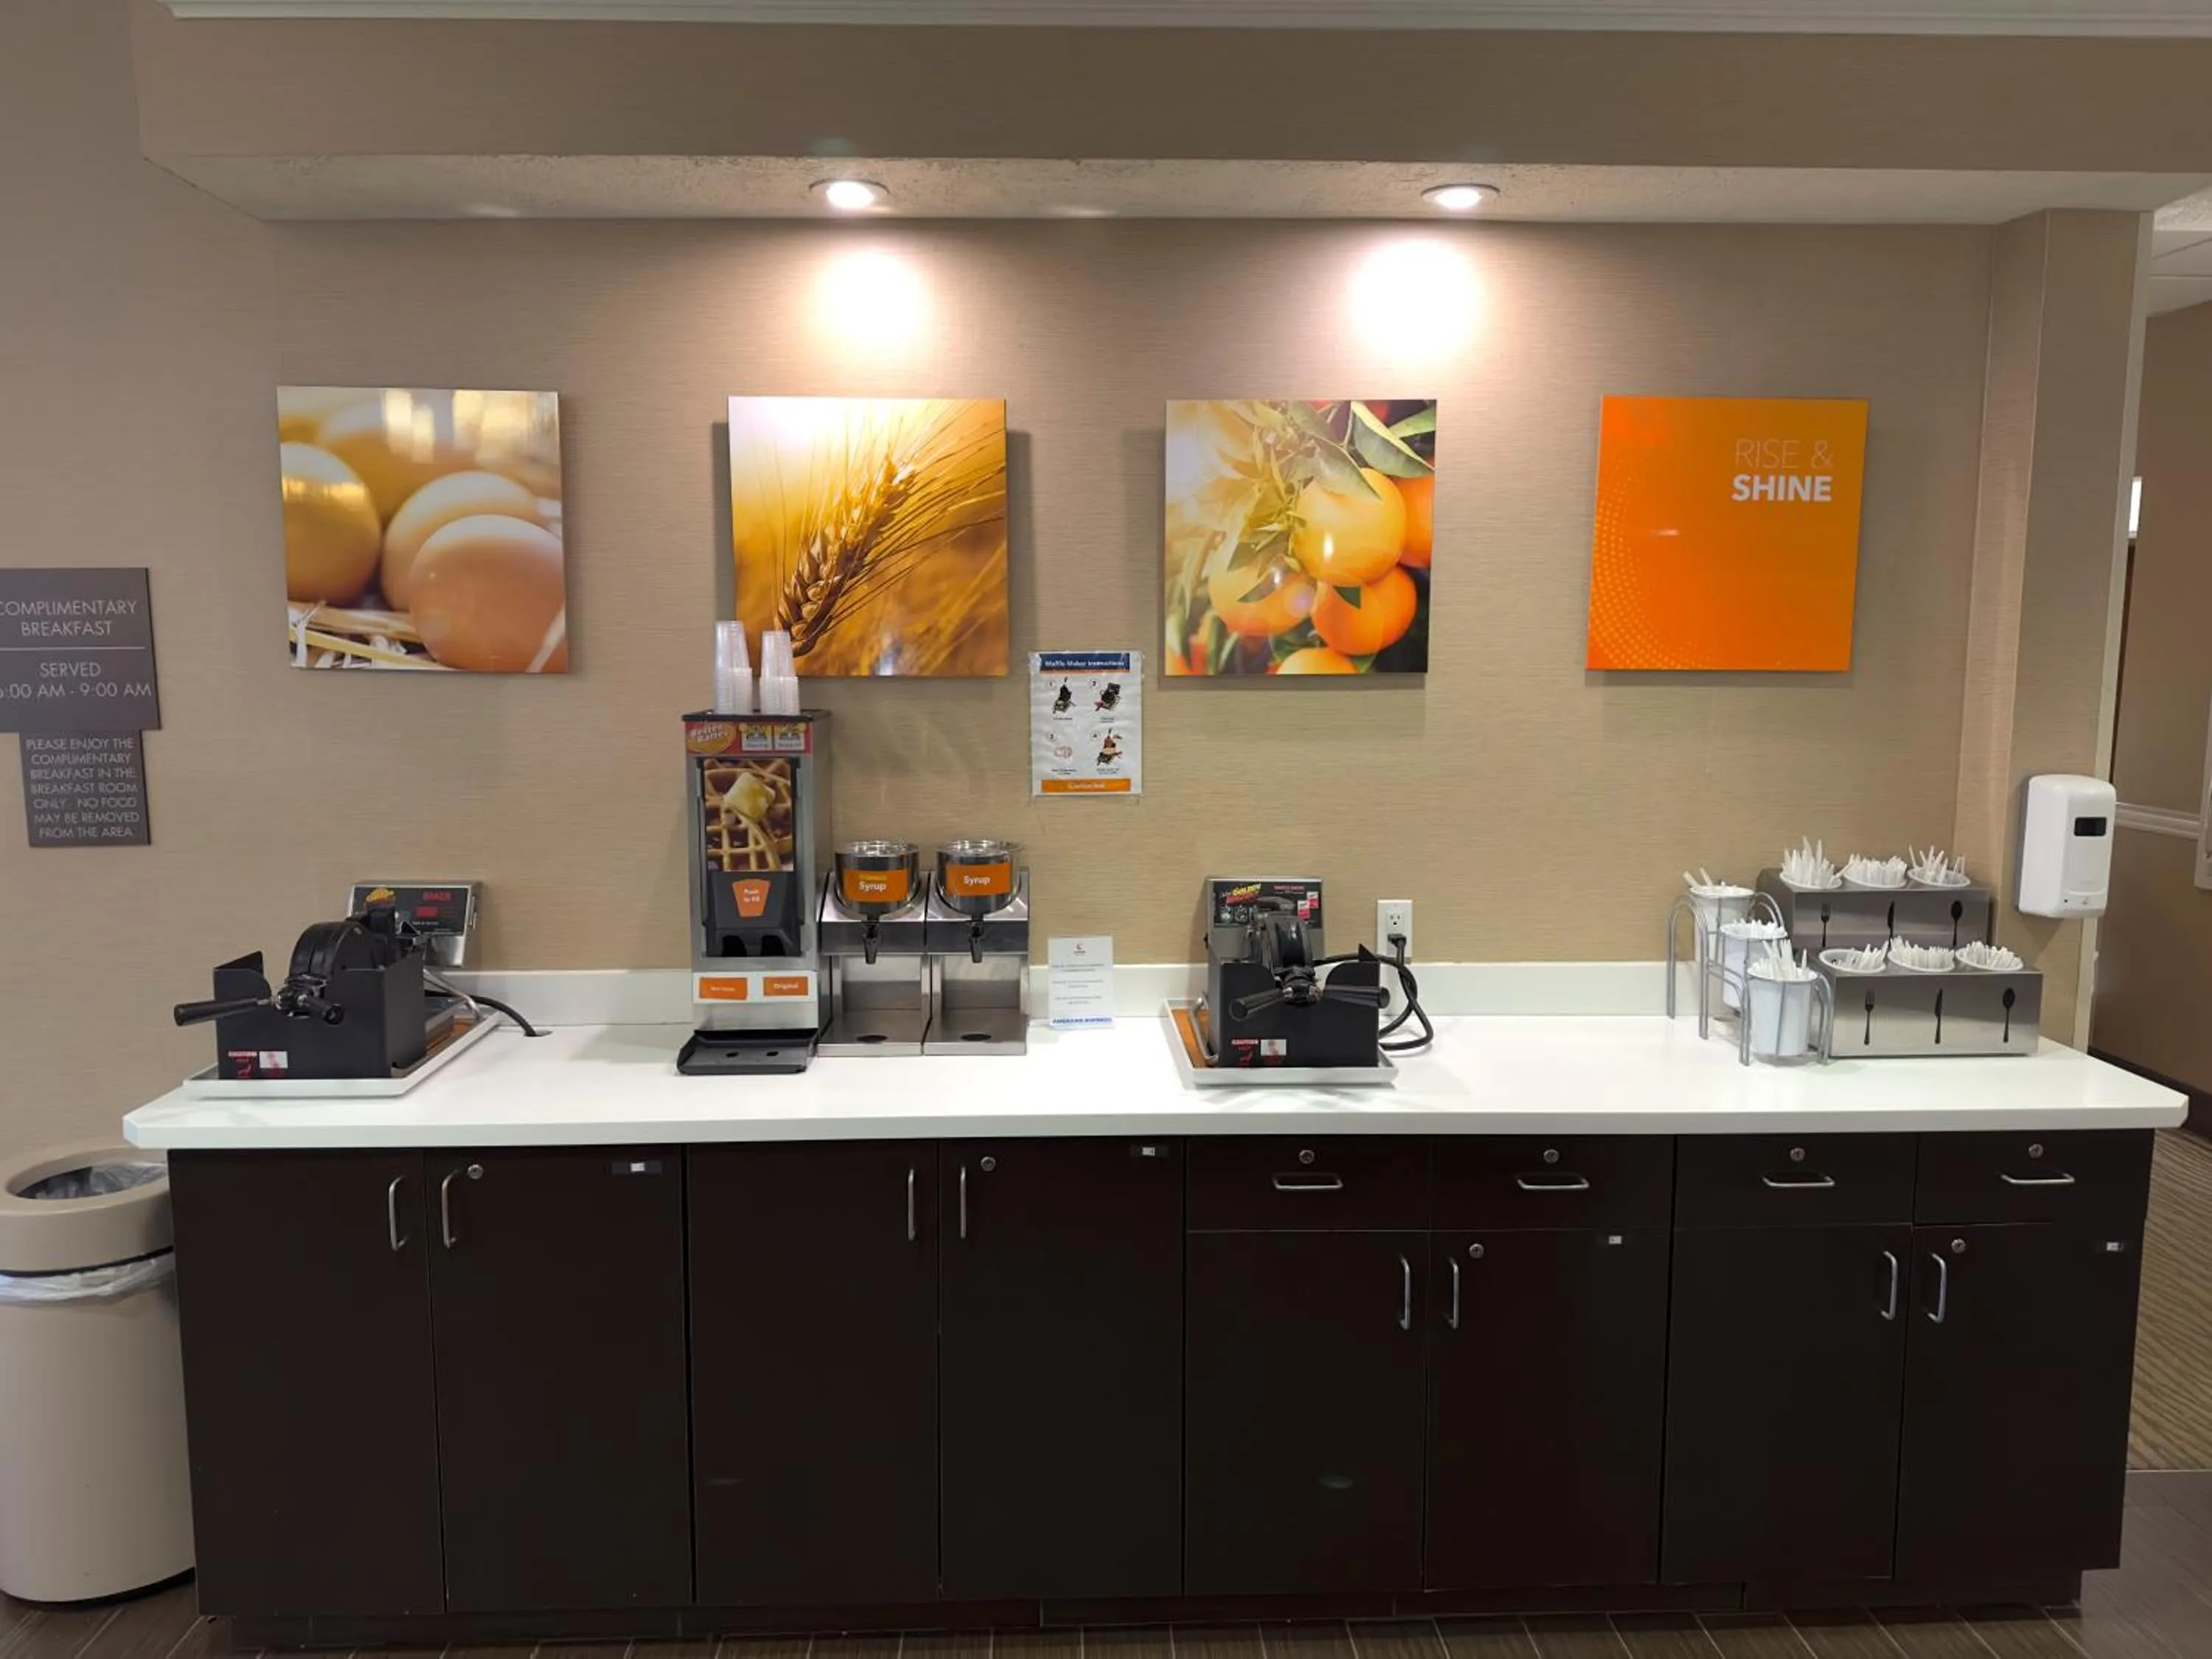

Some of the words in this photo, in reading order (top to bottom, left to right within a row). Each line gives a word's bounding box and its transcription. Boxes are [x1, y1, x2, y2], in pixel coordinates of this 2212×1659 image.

[1735, 439, 1800, 469] RISE
[1811, 439, 1834, 470] &
[1731, 473, 1833, 502] SHINE
[21, 620, 114, 637] BREAKFAST
[39, 661, 102, 678] SERVED
[38, 683, 66, 698] AM
[80, 683, 118, 698] 9:00
[123, 683, 152, 698] AM
[26, 738, 67, 751] PLEASE
[70, 738, 109, 751] ENJOY
[113, 737, 136, 749] THE
[31, 753, 131, 765] COMPLIMENTARY
[30, 768, 94, 779] BREAKFAST
[97, 768, 111, 779] IN
[114, 768, 137, 778] THE
[30, 782, 94, 794] BREAKFAST
[98, 782, 138, 793] ROOM
[77, 798, 99, 808] NO
[102, 798, 137, 808] FOOD
[34, 813, 60, 824] MAY
[64, 813, 79, 824] BE
[81, 812, 140, 823] REMOVED
[39, 827, 73, 838] FROM
[78, 827, 98, 838] THE
[101, 827, 133, 837] AREA
[858, 881, 887, 892] Syrup
[963, 875, 991, 886] Syrup
